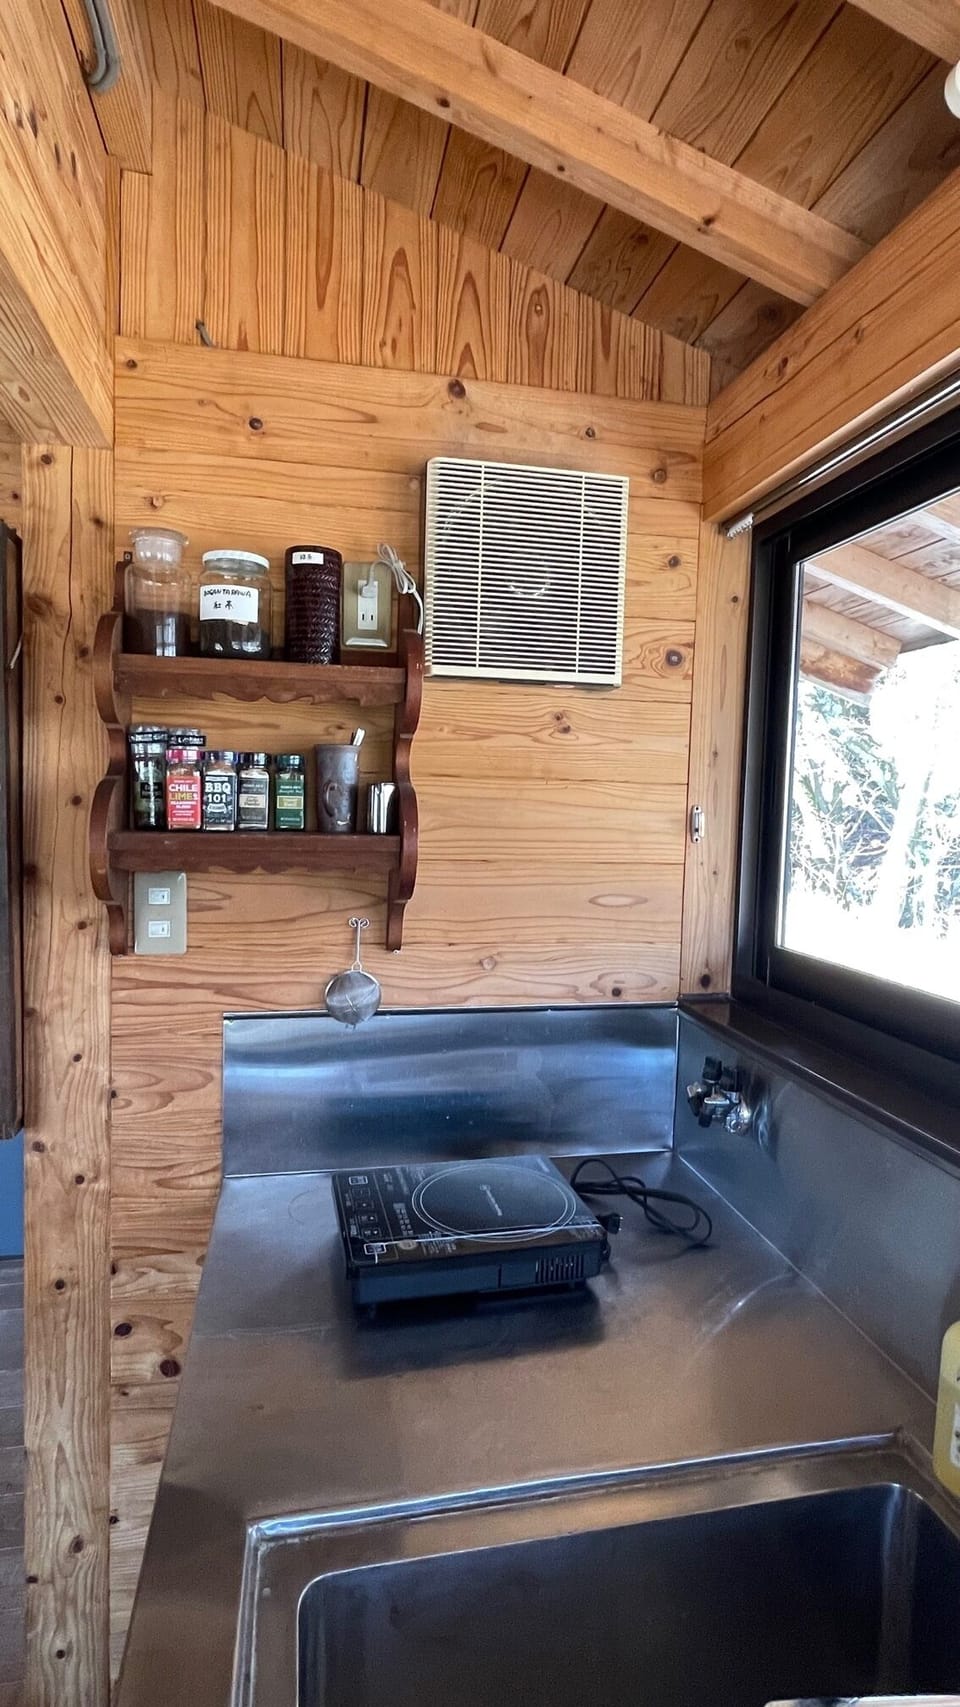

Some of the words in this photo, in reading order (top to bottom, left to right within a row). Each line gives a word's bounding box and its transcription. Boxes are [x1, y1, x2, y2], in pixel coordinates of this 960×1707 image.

[168, 783, 199, 792] CHILE
[204, 782, 231, 795] BBQ
[169, 792, 193, 801] LIME
[207, 793, 227, 803] 101
